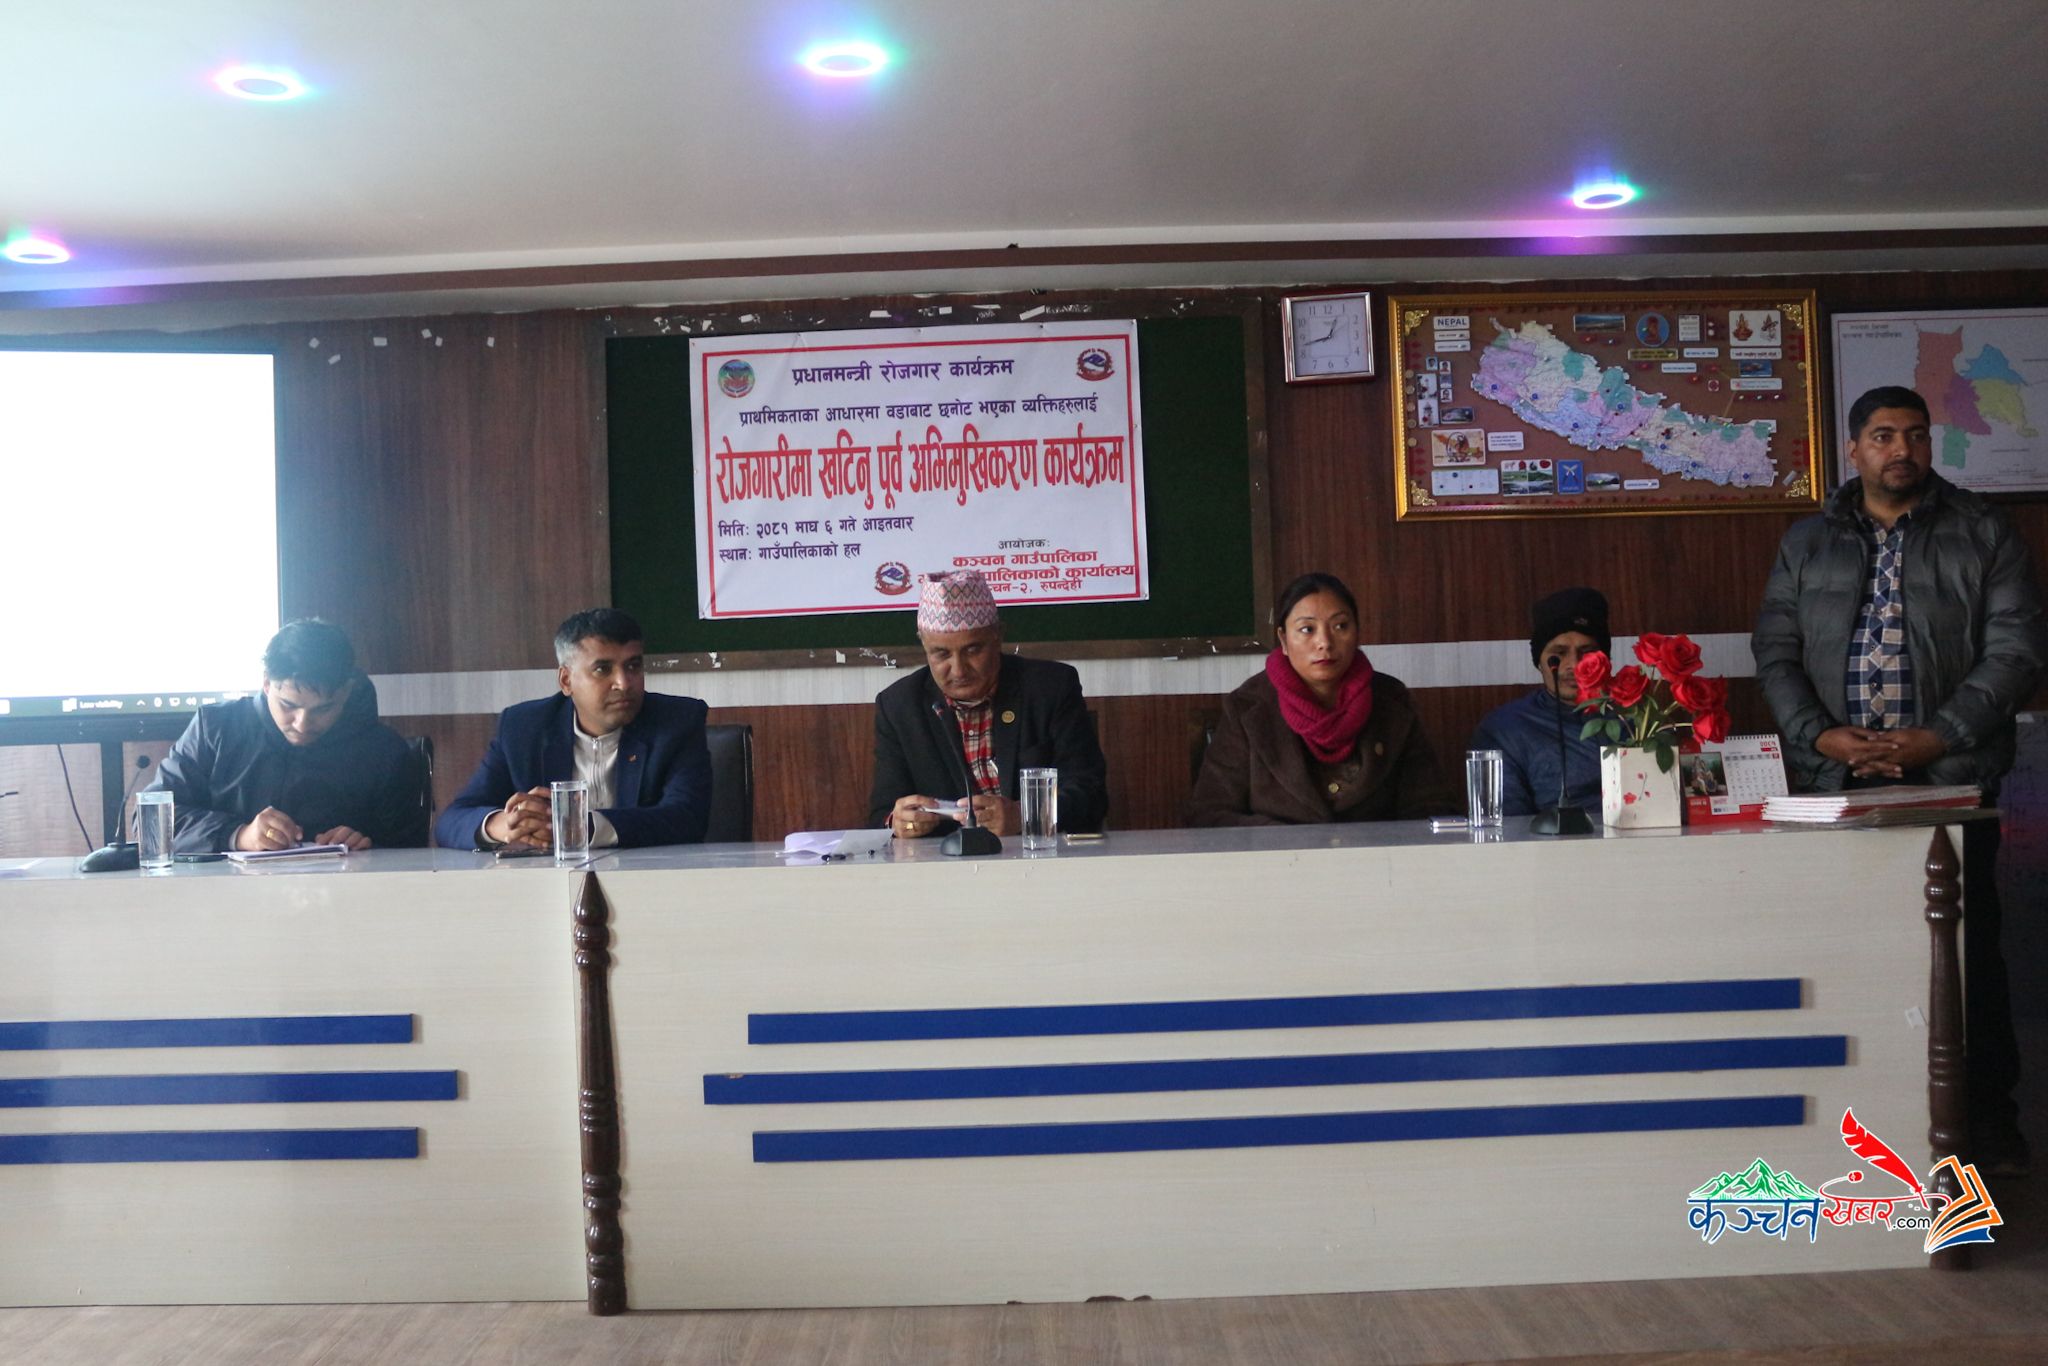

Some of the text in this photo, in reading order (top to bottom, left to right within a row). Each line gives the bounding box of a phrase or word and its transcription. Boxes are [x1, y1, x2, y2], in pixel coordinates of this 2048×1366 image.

[1309, 306, 1316, 316] 11
[1324, 304, 1333, 314] 12
[1299, 318, 1306, 328] 10
[1353, 314, 1359, 325] 2
[1437, 318, 1467, 326] NEPAL
[1353, 330, 1359, 339] 3
[1300, 350, 1306, 359] 8
[1354, 347, 1360, 356] 4
[1312, 360, 1318, 370] 7
[1328, 360, 1334, 369] 6
[1344, 358, 1350, 368] 5
[792, 356, 1014, 386] प्रधानमन्त्री रोजगार कार्यक्रम
[739, 405, 819, 427] प्राथमिकताका
[825, 405, 880, 422] आधारमा
[886, 404, 932, 419] वडाबाट
[938, 399, 973, 418] छनोट
[979, 400, 1016, 418] भएका
[716, 422, 1124, 510] रोजगारीमा खटिनु पूर्व अभिमुखिकरण कार्यक्रम
[756, 522, 789, 539] २०८१
[795, 520, 819, 534] माघ
[825, 520, 833, 535] ६
[839, 516, 857, 532] गते
[758, 540, 838, 560] गाउँपालिकाको
[843, 543, 861, 558] हल
[952, 555, 1005, 568] कञ्चन
[1065, 563, 1135, 578] कार्यालय
